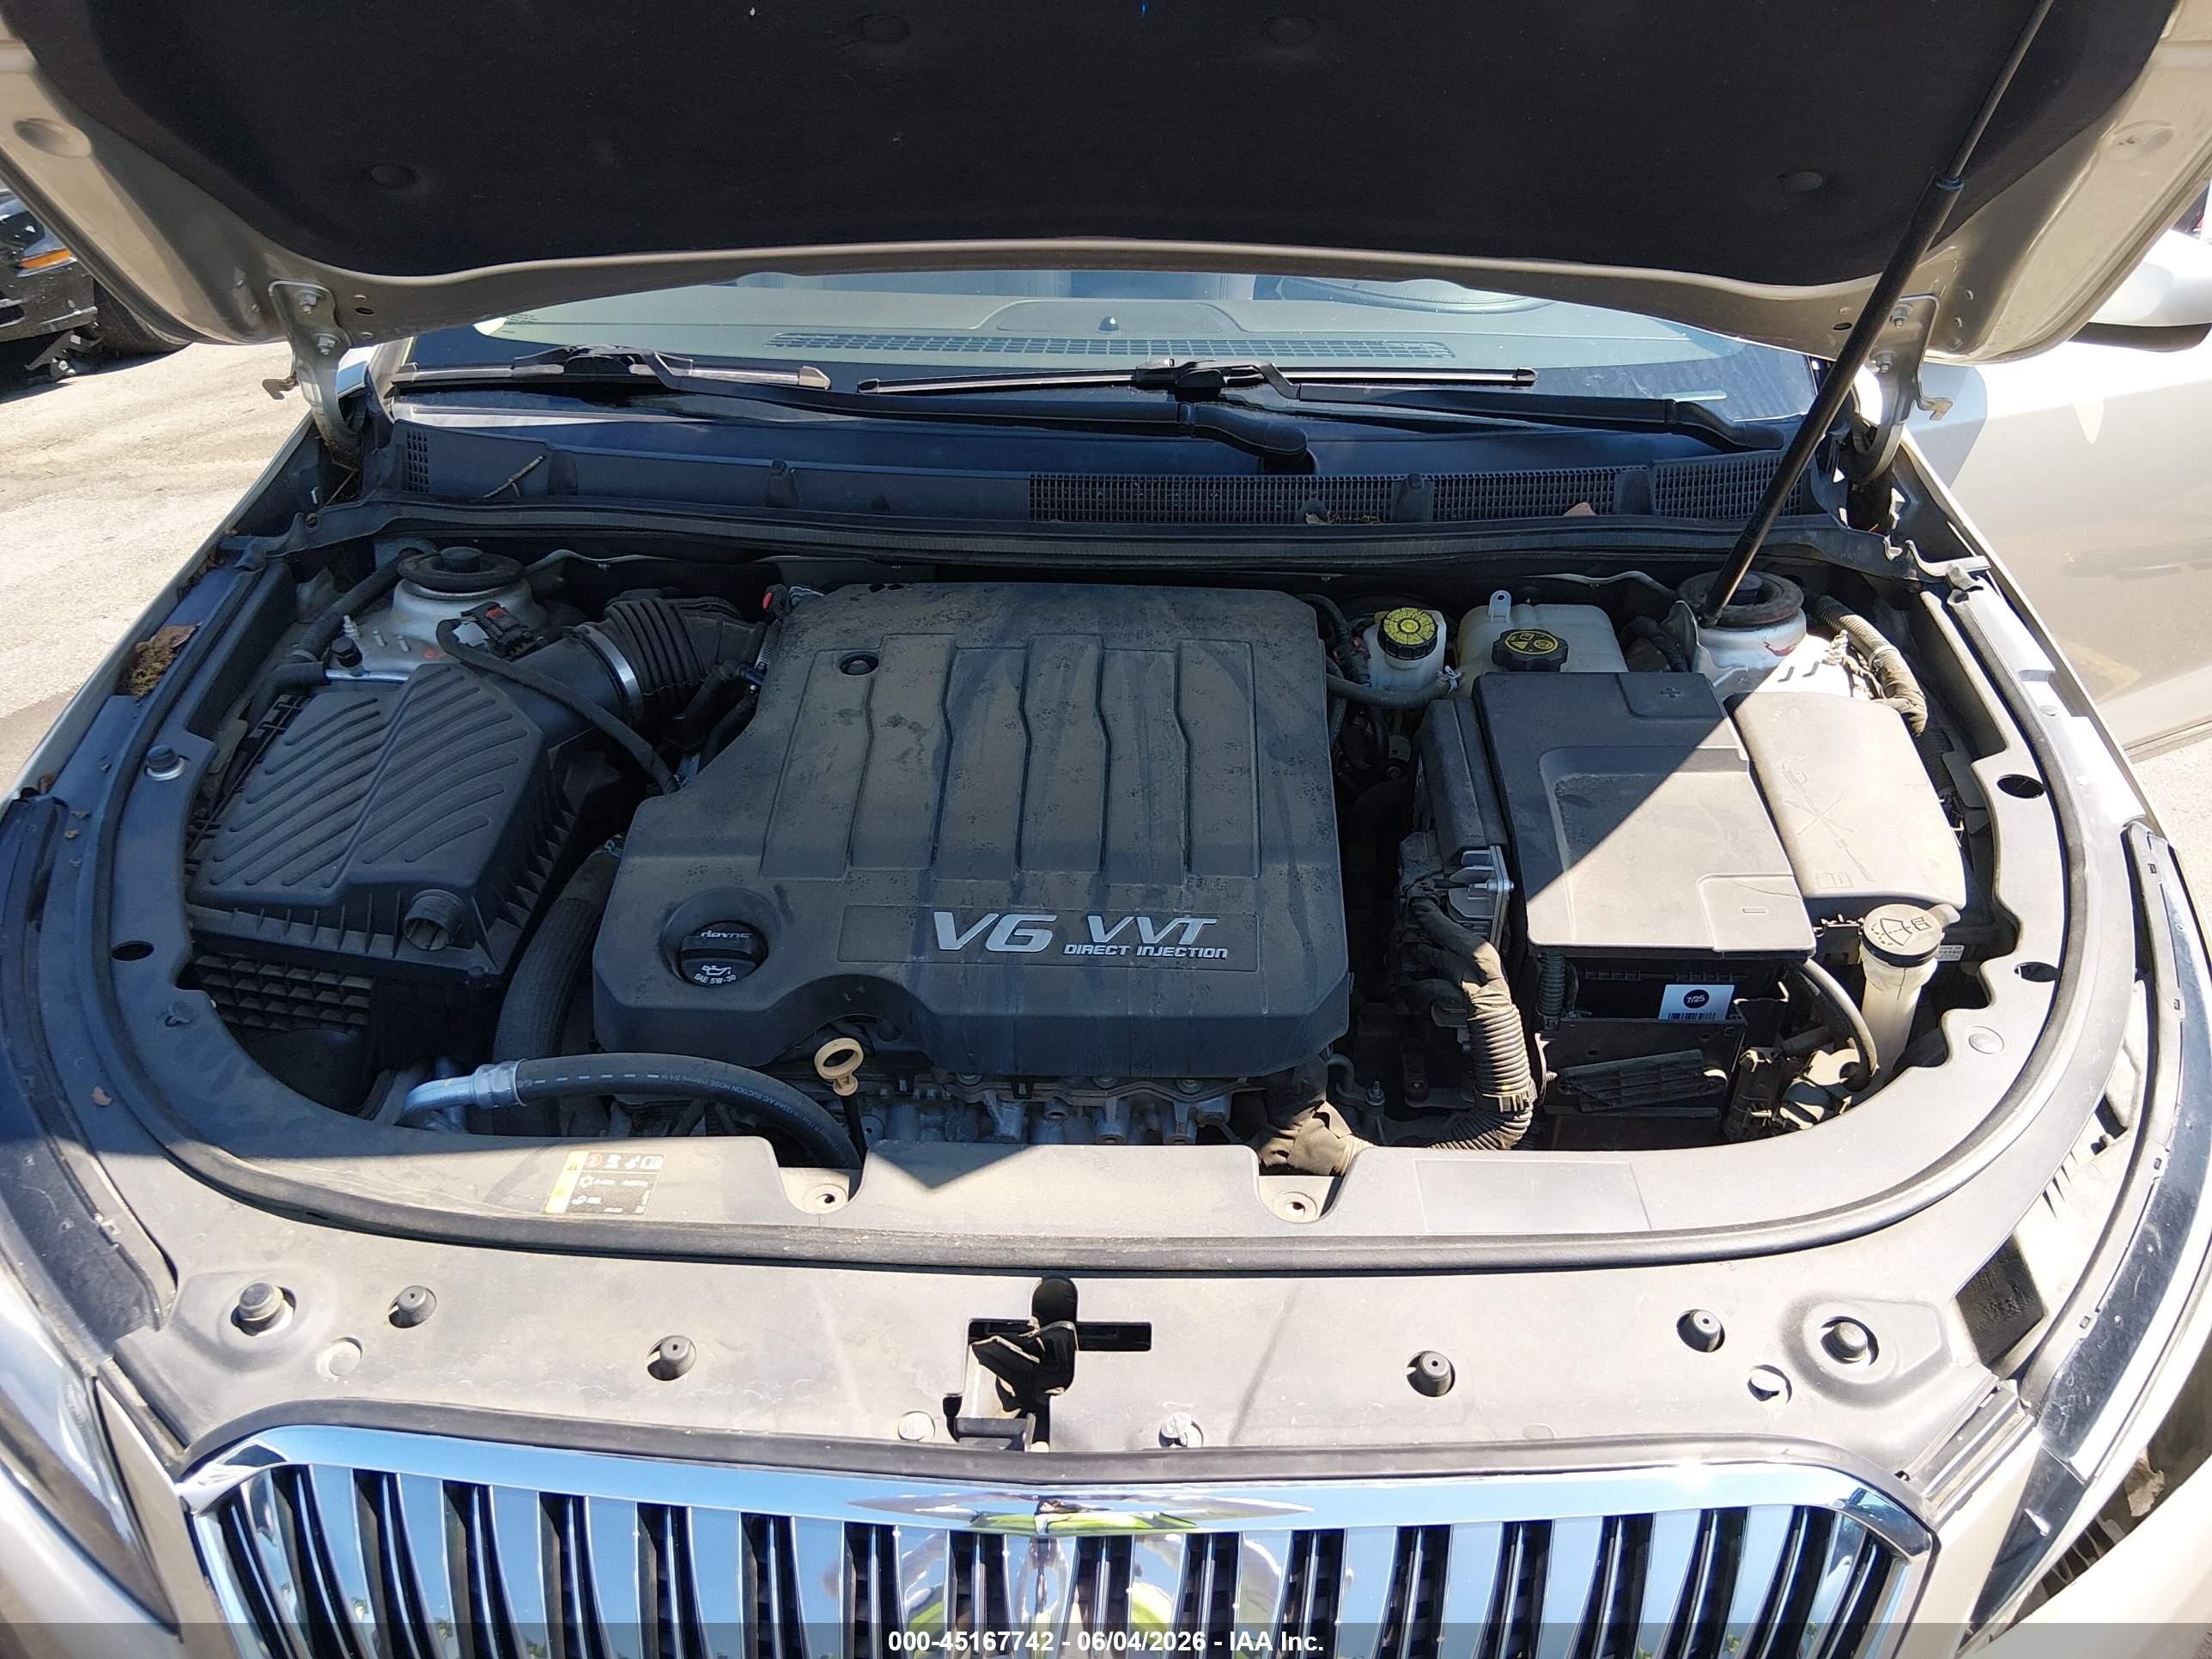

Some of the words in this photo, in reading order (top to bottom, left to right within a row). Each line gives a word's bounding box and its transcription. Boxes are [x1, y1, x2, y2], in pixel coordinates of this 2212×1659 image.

[933, 911, 1057, 952] V6
[1087, 915, 1218, 945] VVT
[1063, 944, 1130, 957] DIRECT
[1136, 945, 1229, 959] INJECTION
[694, 973, 709, 983] SAE
[710, 974, 737, 984] 5W-30
